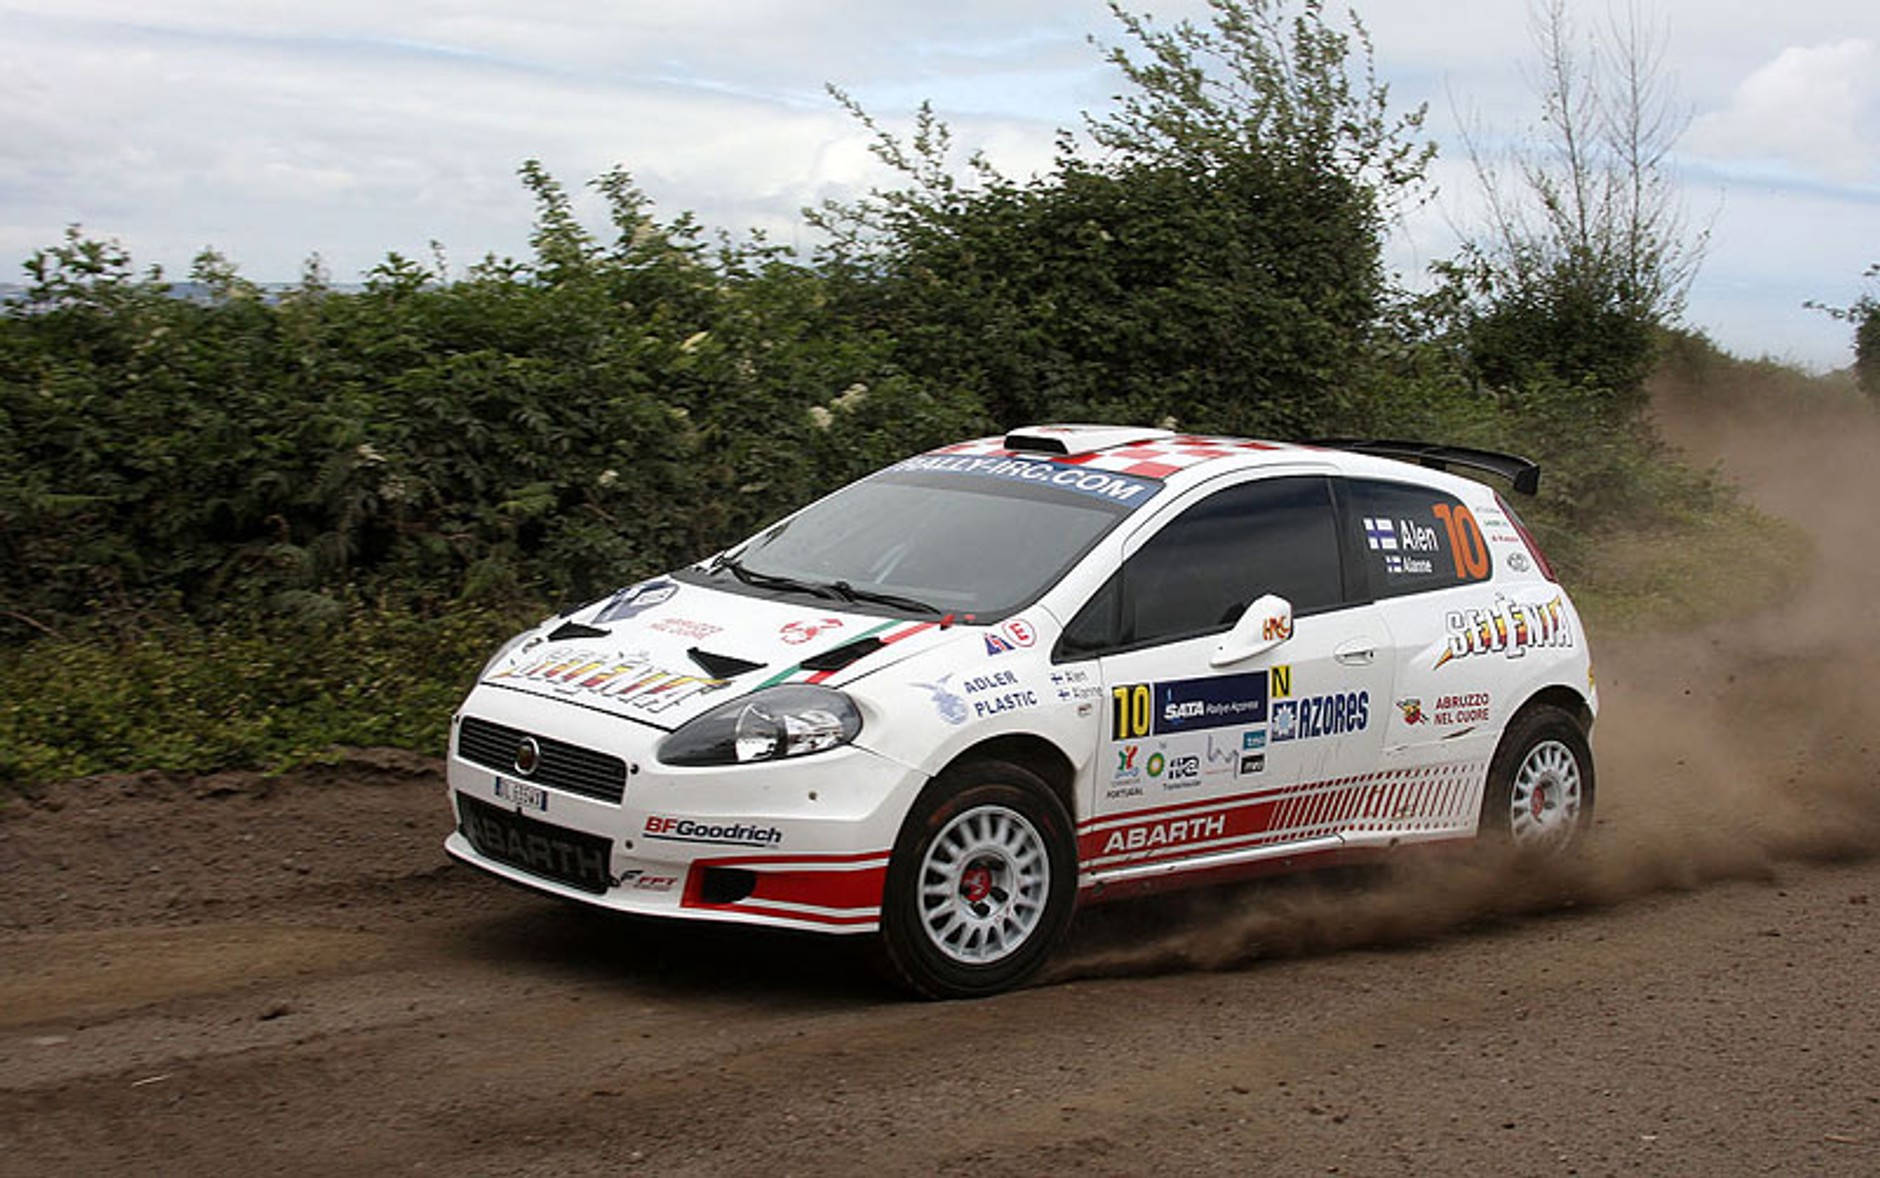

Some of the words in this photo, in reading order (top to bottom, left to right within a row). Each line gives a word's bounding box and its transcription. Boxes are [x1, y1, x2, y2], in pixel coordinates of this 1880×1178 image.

[1400, 519, 1439, 551] Alen
[1431, 503, 1488, 579] 10
[963, 670, 1019, 694] ADLER
[1272, 667, 1290, 698] N
[973, 690, 1038, 718] PLASTIC
[1113, 684, 1150, 739] 10
[1163, 701, 1205, 720] SATA
[1435, 693, 1489, 710] ABRUZZO
[1434, 710, 1454, 725] NEL
[1456, 708, 1489, 724] CUORE
[1106, 787, 1143, 799] PORTUGAL
[644, 816, 782, 843] BFGoodrich
[1103, 814, 1226, 854] ABARTH
